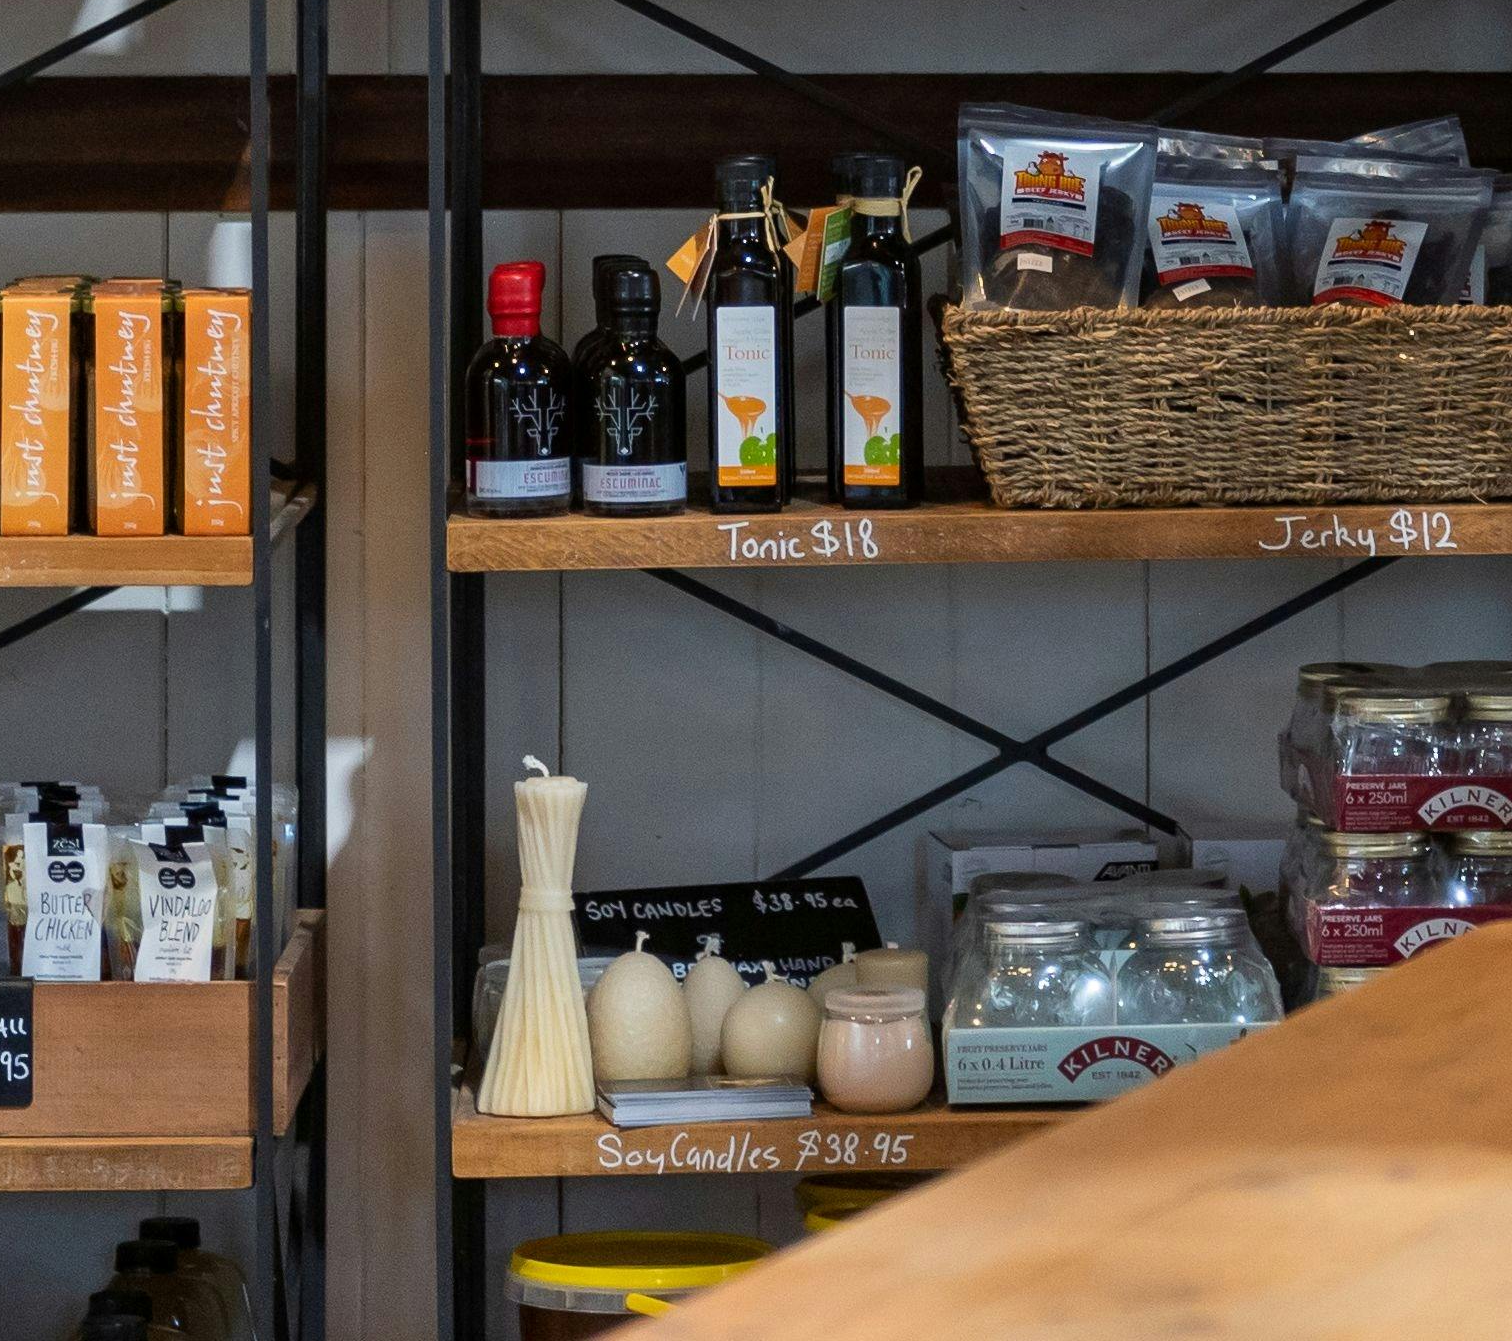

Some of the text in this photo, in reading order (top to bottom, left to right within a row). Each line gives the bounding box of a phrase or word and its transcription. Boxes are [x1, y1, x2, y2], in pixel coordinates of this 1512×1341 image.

[725, 345, 769, 360] Tonic
[9, 310, 58, 425] chutney
[191, 309, 241, 431] chutney
[601, 477, 662, 489] ESCUMINAC
[717, 519, 879, 560] Tonic $18
[1259, 511, 1457, 556] Jerky $12
[1346, 782, 1406, 791] PRESERVE JARS
[1369, 791, 1407, 805] 250ml
[41, 893, 92, 916] BUTTER
[149, 895, 211, 917] VINDALOO
[585, 899, 722, 920] SOY CANDLES
[35, 919, 93, 940] CHICKEN
[1009, 1056, 1045, 1070] Litre
